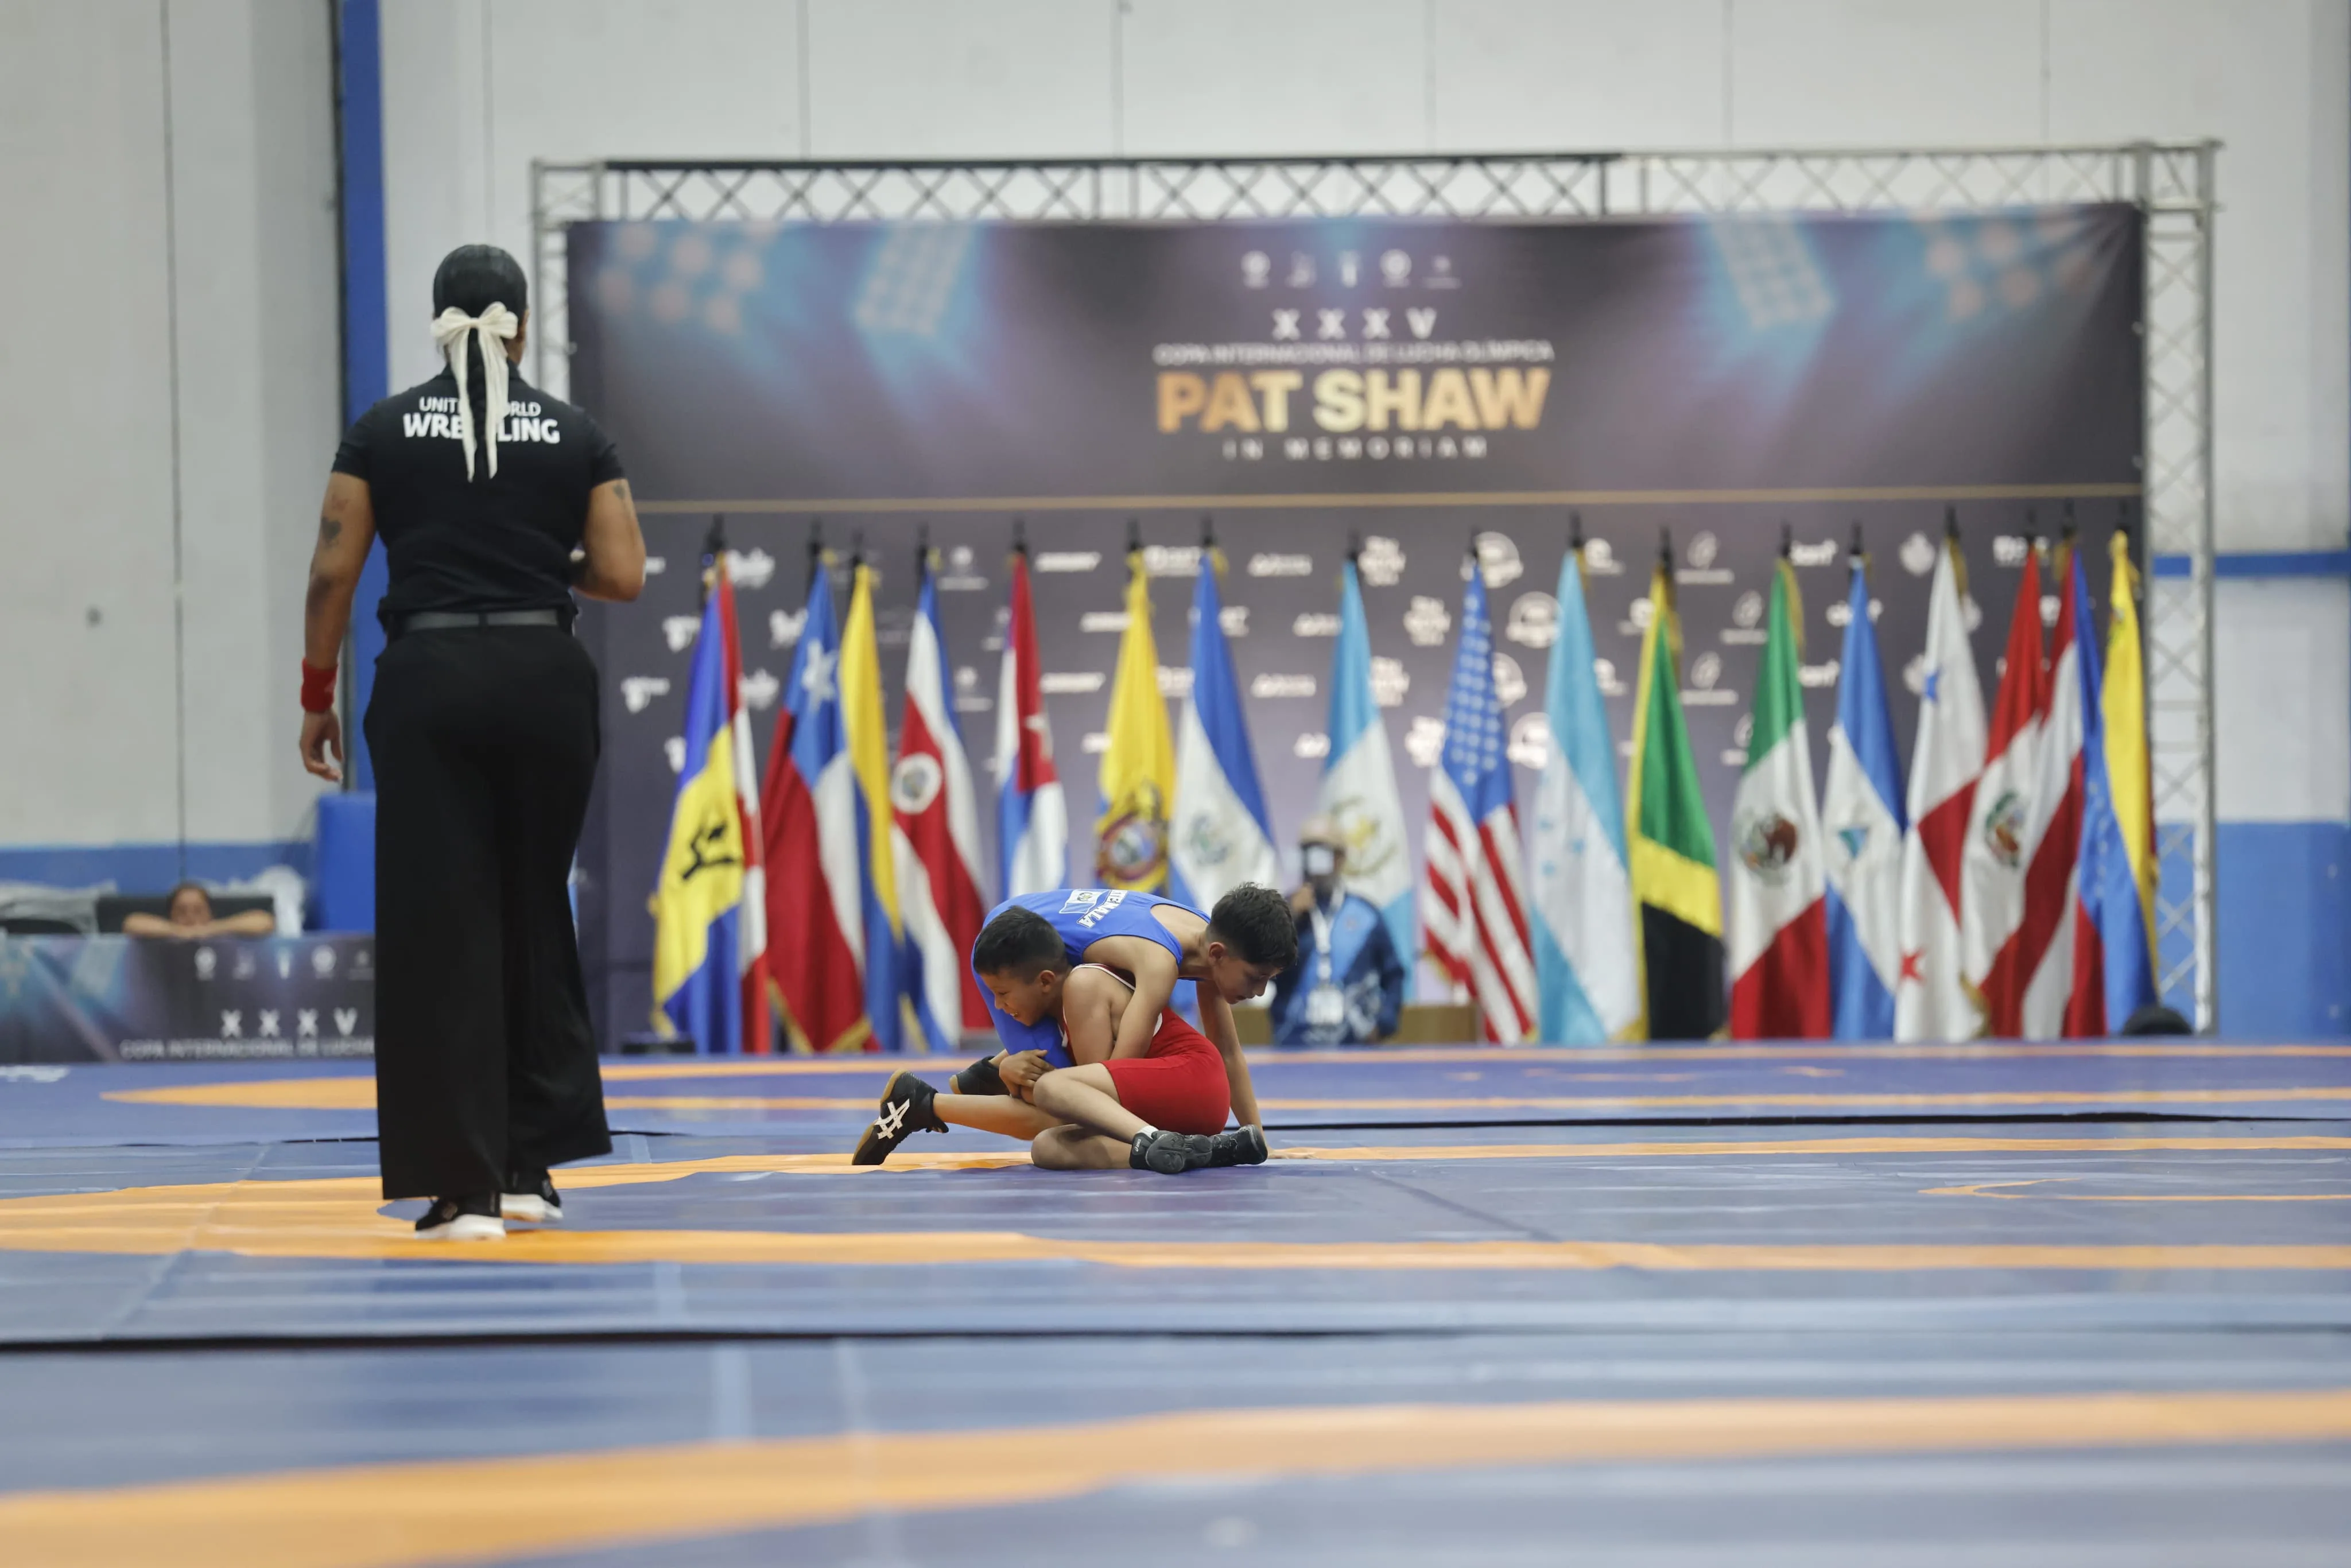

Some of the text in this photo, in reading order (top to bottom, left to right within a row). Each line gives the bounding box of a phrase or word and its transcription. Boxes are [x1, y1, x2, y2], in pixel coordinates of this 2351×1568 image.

[419, 396, 460, 413] UNIT
[1156, 367, 1551, 433] PAT SHAW
[403, 412, 560, 444] WRELING
[1222, 436, 1488, 460] IN MEMORIAM
